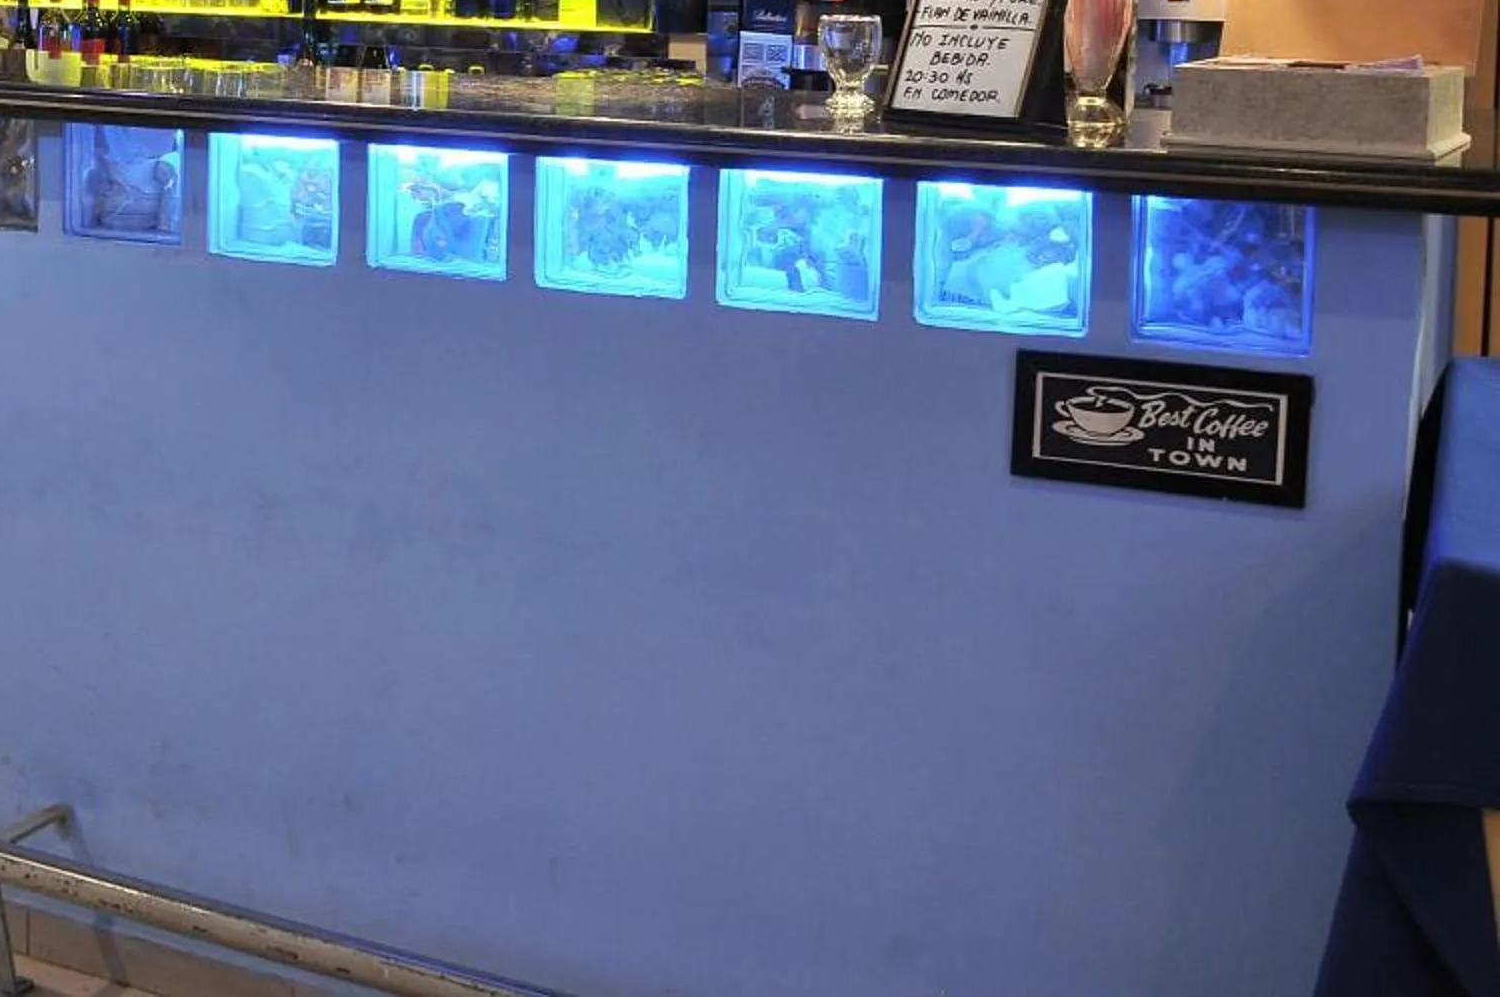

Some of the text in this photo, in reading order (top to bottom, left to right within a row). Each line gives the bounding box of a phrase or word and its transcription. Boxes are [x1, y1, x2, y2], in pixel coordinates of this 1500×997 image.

[953, 7, 971, 22] DE
[909, 29, 932, 47] NO
[903, 86, 923, 99] EN
[1137, 399, 1269, 439] Best Coffee
[1186, 436, 1216, 453] IN
[1147, 448, 1248, 472] TOWN
